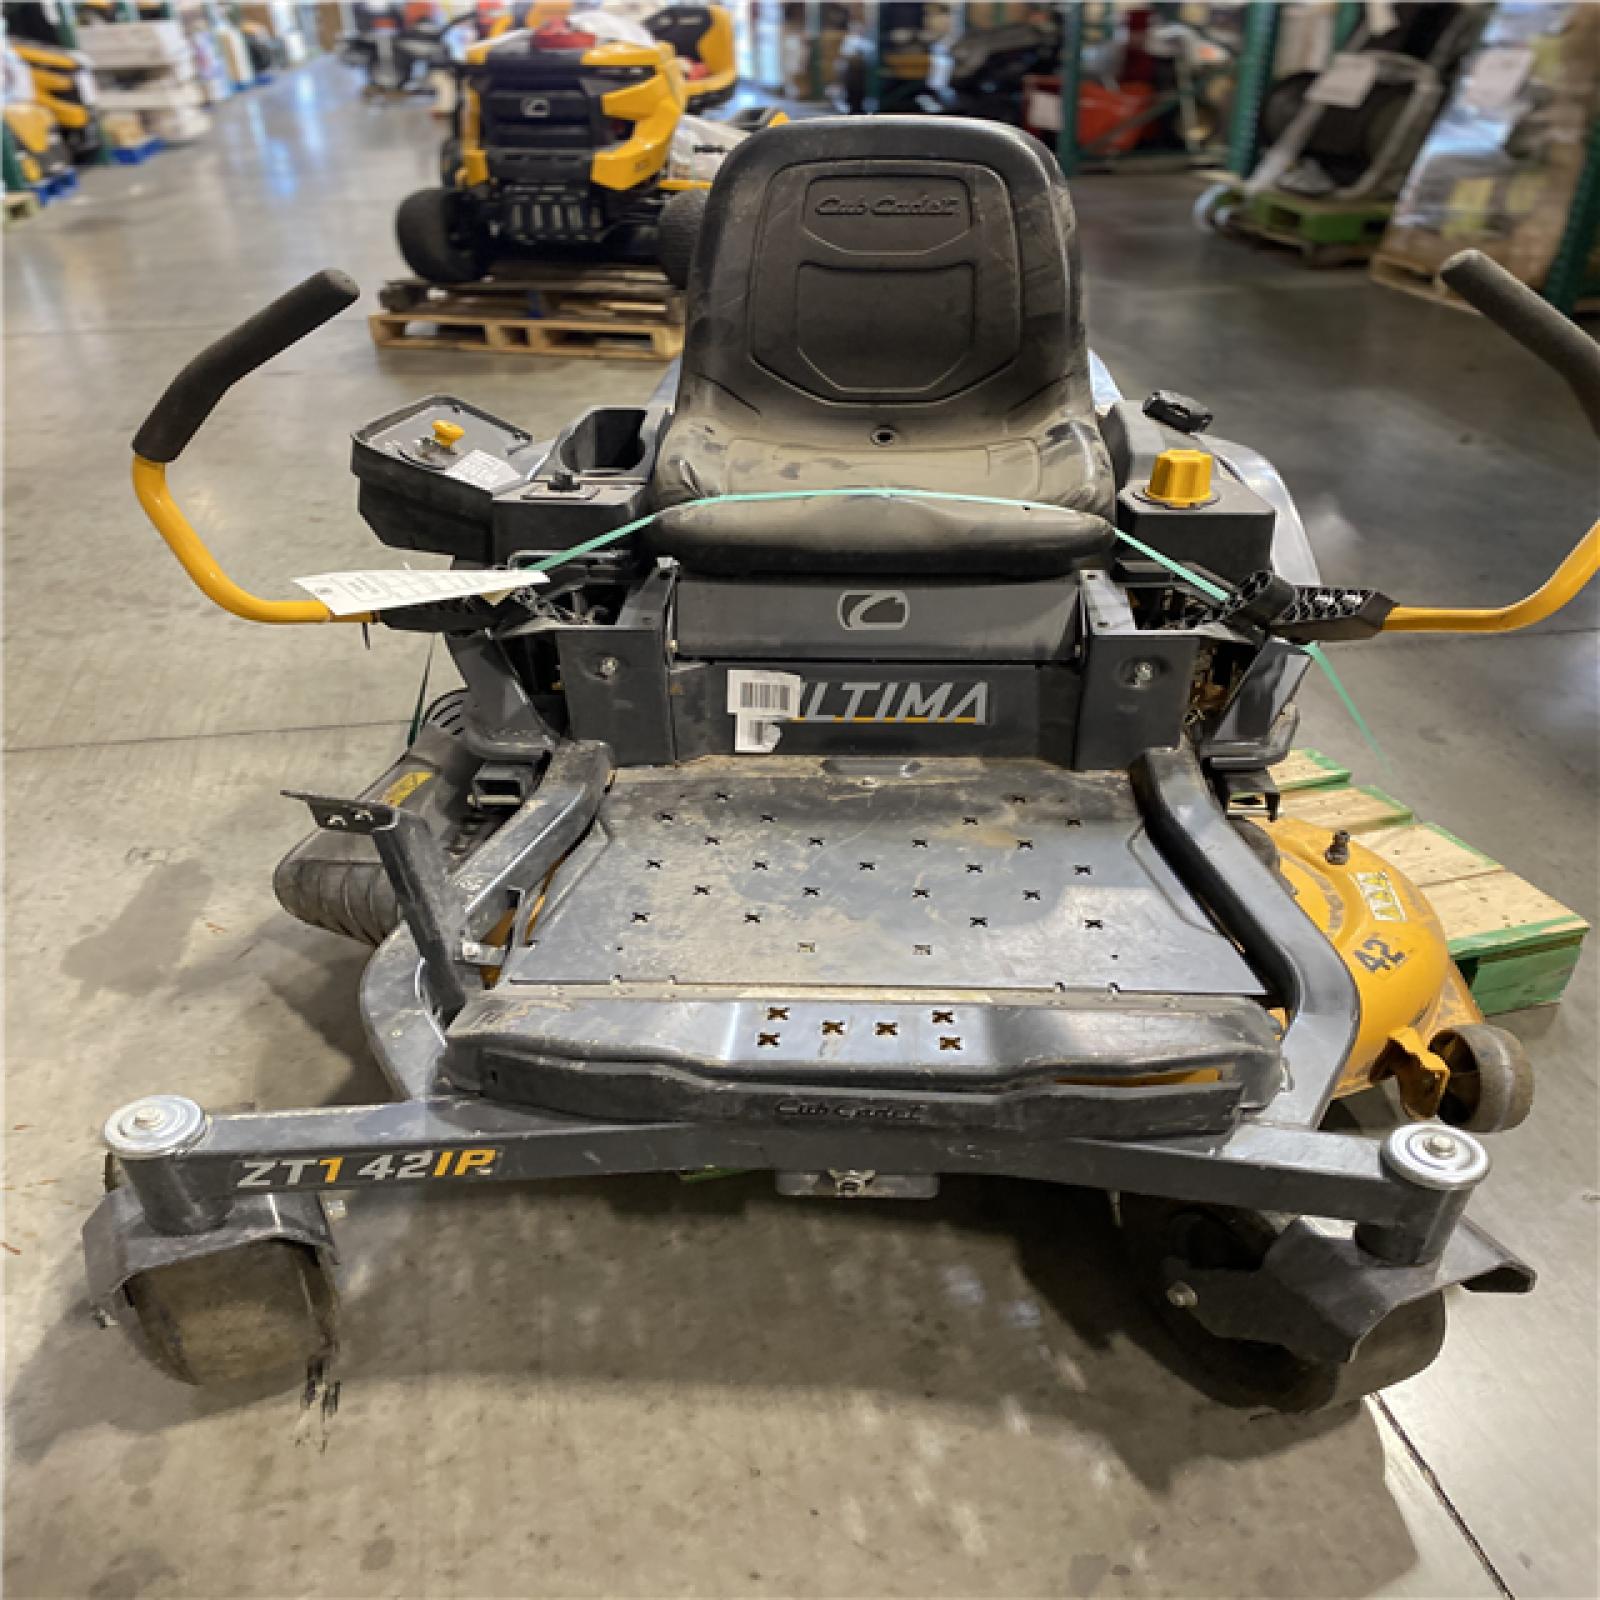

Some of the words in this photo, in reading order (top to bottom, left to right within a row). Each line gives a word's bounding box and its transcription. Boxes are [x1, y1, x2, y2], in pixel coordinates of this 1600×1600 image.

[799, 681, 988, 725] LTIMA
[1353, 934, 1406, 974] 42
[237, 1156, 344, 1188] ZT1
